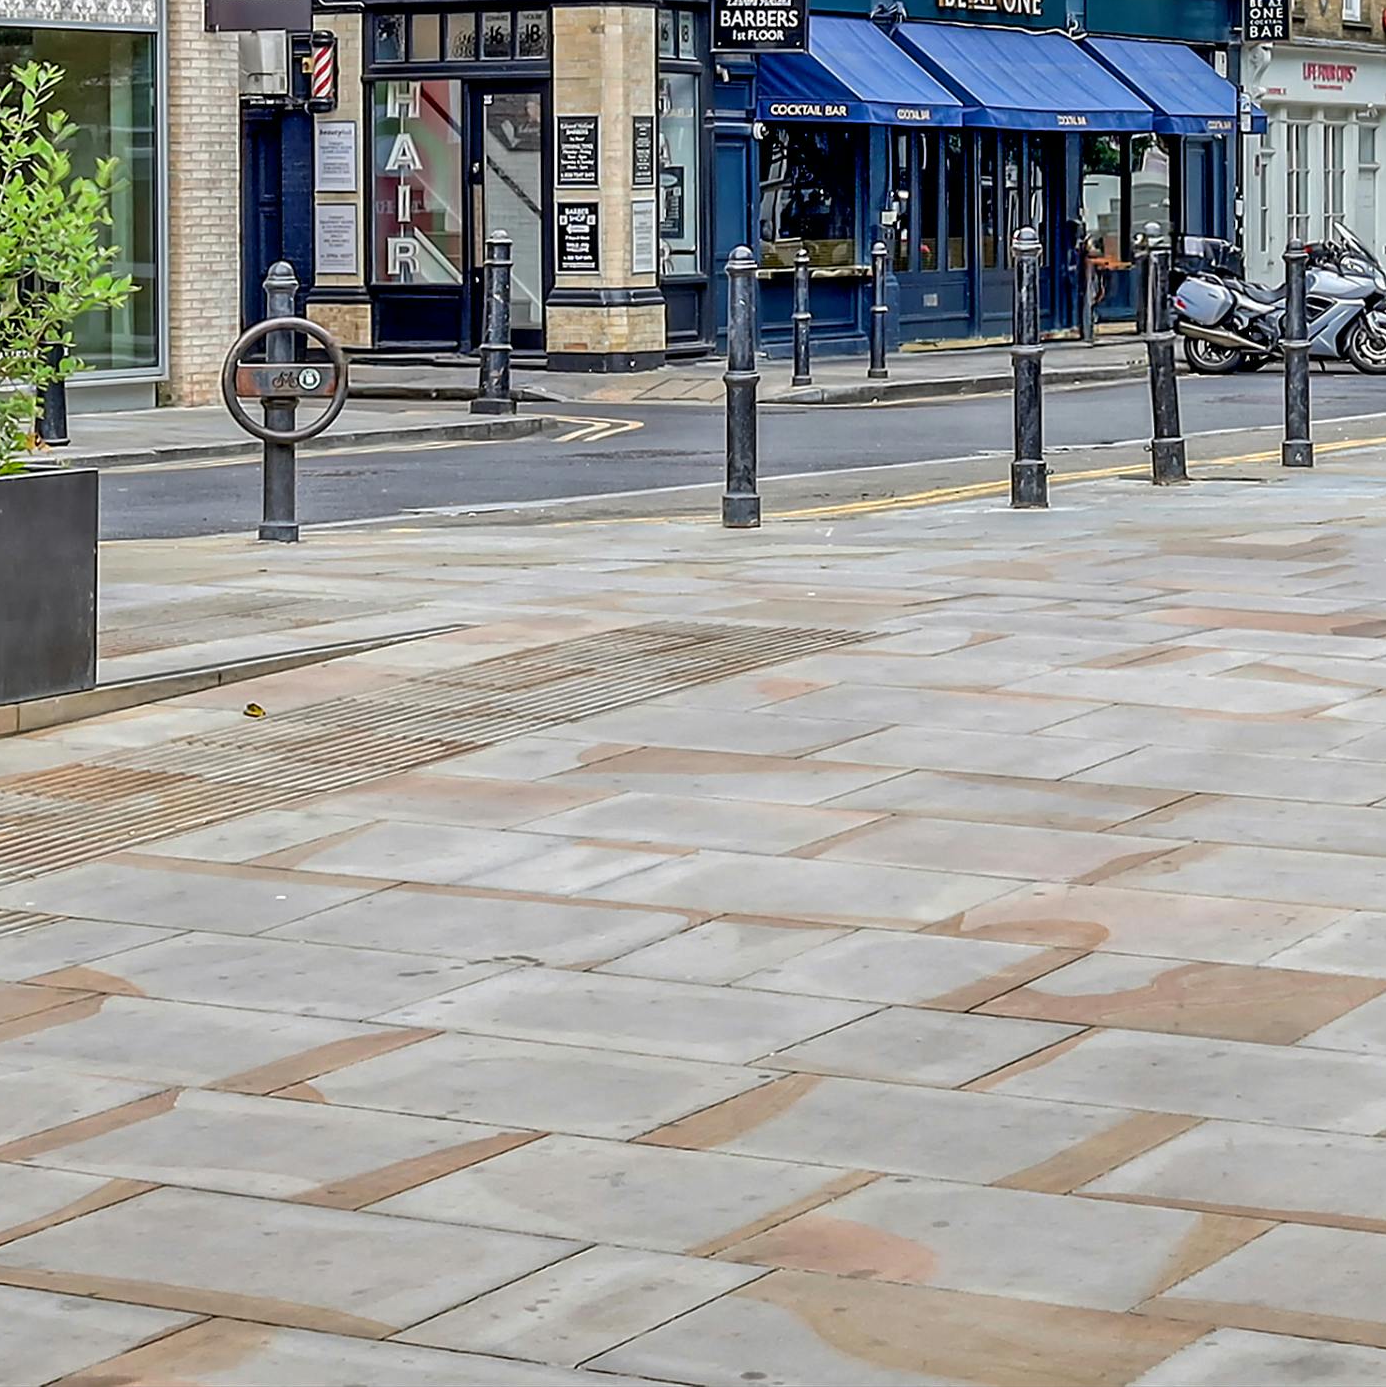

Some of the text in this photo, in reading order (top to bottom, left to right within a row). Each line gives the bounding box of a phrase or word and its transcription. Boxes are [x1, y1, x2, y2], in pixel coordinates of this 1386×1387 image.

[720, 10, 799, 28] BARBERS
[1250, 7, 1284, 19] ONE
[732, 29, 785, 42] 1st FLOOR
[1249, 25, 1283, 38] BAR
[770, 103, 848, 117] COCKTAIL BAR
[385, 81, 423, 275] HAIR
